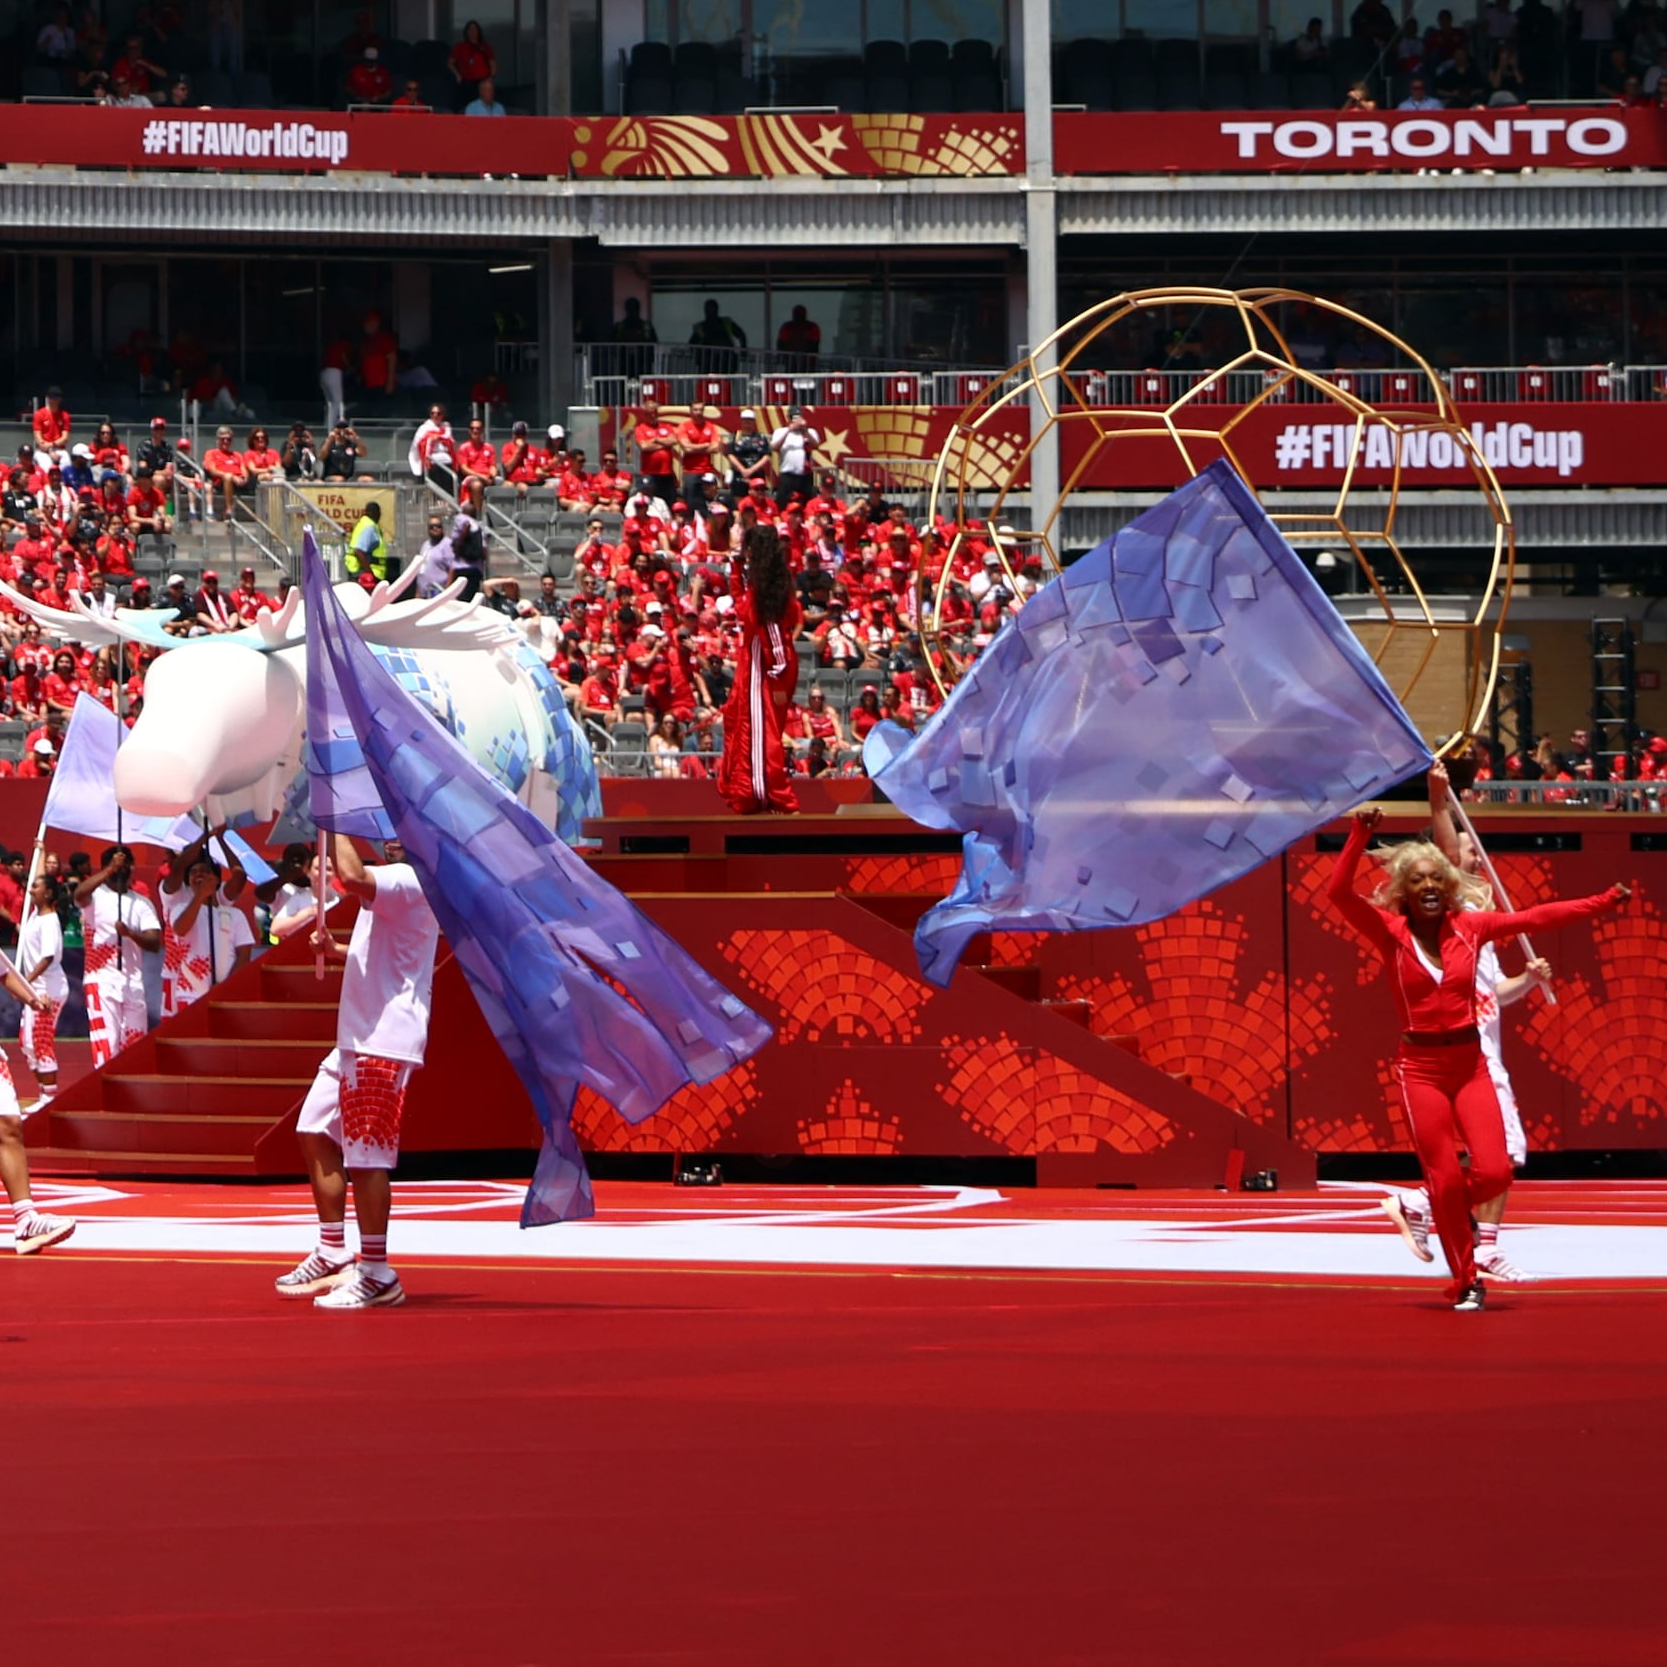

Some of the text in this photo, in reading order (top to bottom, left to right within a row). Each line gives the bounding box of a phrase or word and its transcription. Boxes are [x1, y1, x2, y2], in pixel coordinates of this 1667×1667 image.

[143, 120, 348, 165] #FIFAWorldCup
[1221, 118, 1627, 157] TORONTO
[1275, 421, 1584, 476] #FIFAWorldCup
[318, 494, 345, 505] FIFA
